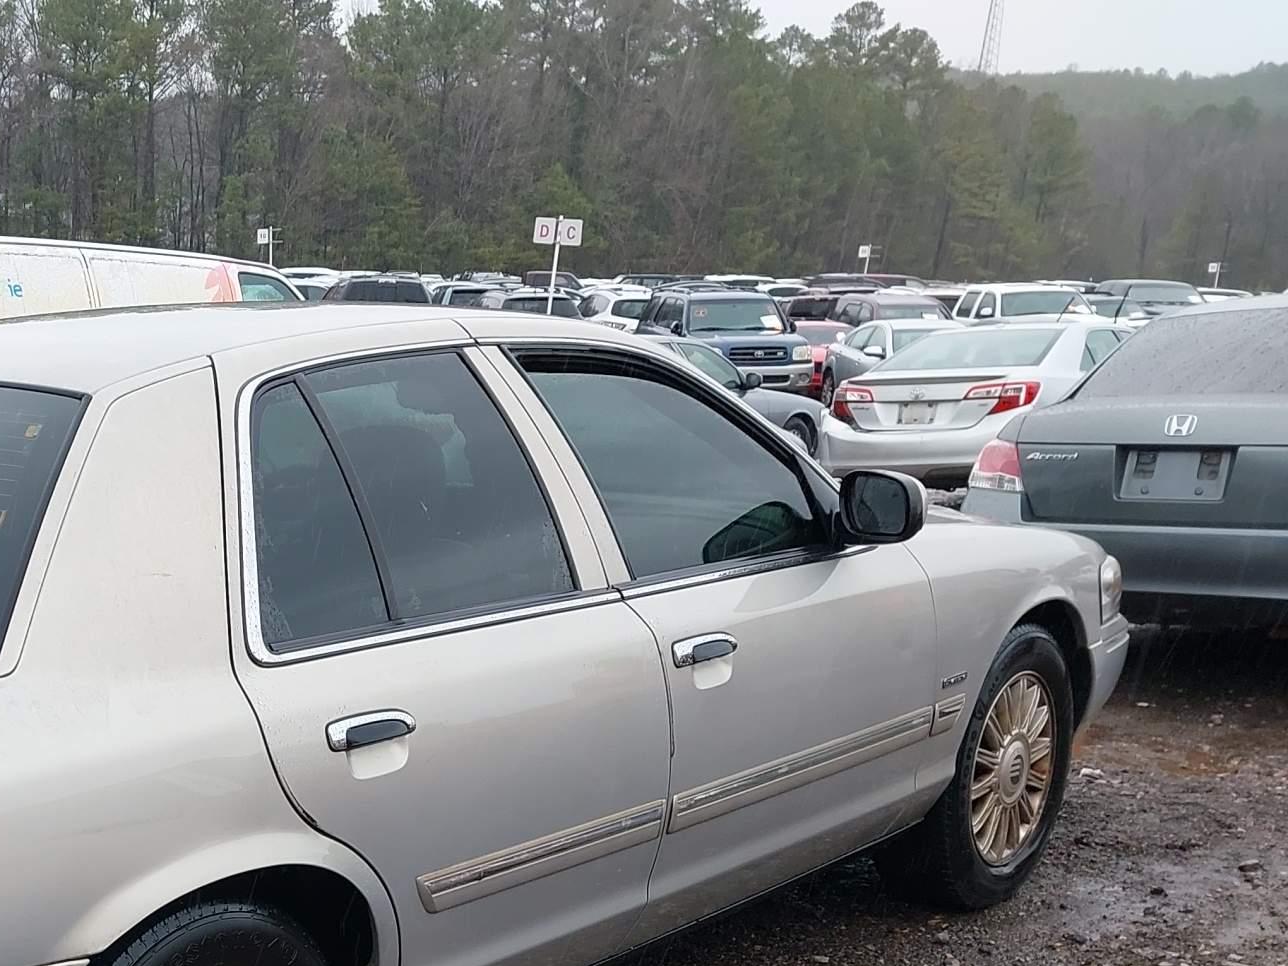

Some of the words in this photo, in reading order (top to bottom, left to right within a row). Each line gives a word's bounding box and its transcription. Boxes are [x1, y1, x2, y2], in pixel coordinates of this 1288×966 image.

[540, 224, 550, 238] D
[567, 225, 577, 240] C
[1026, 452, 1079, 461] Accord
